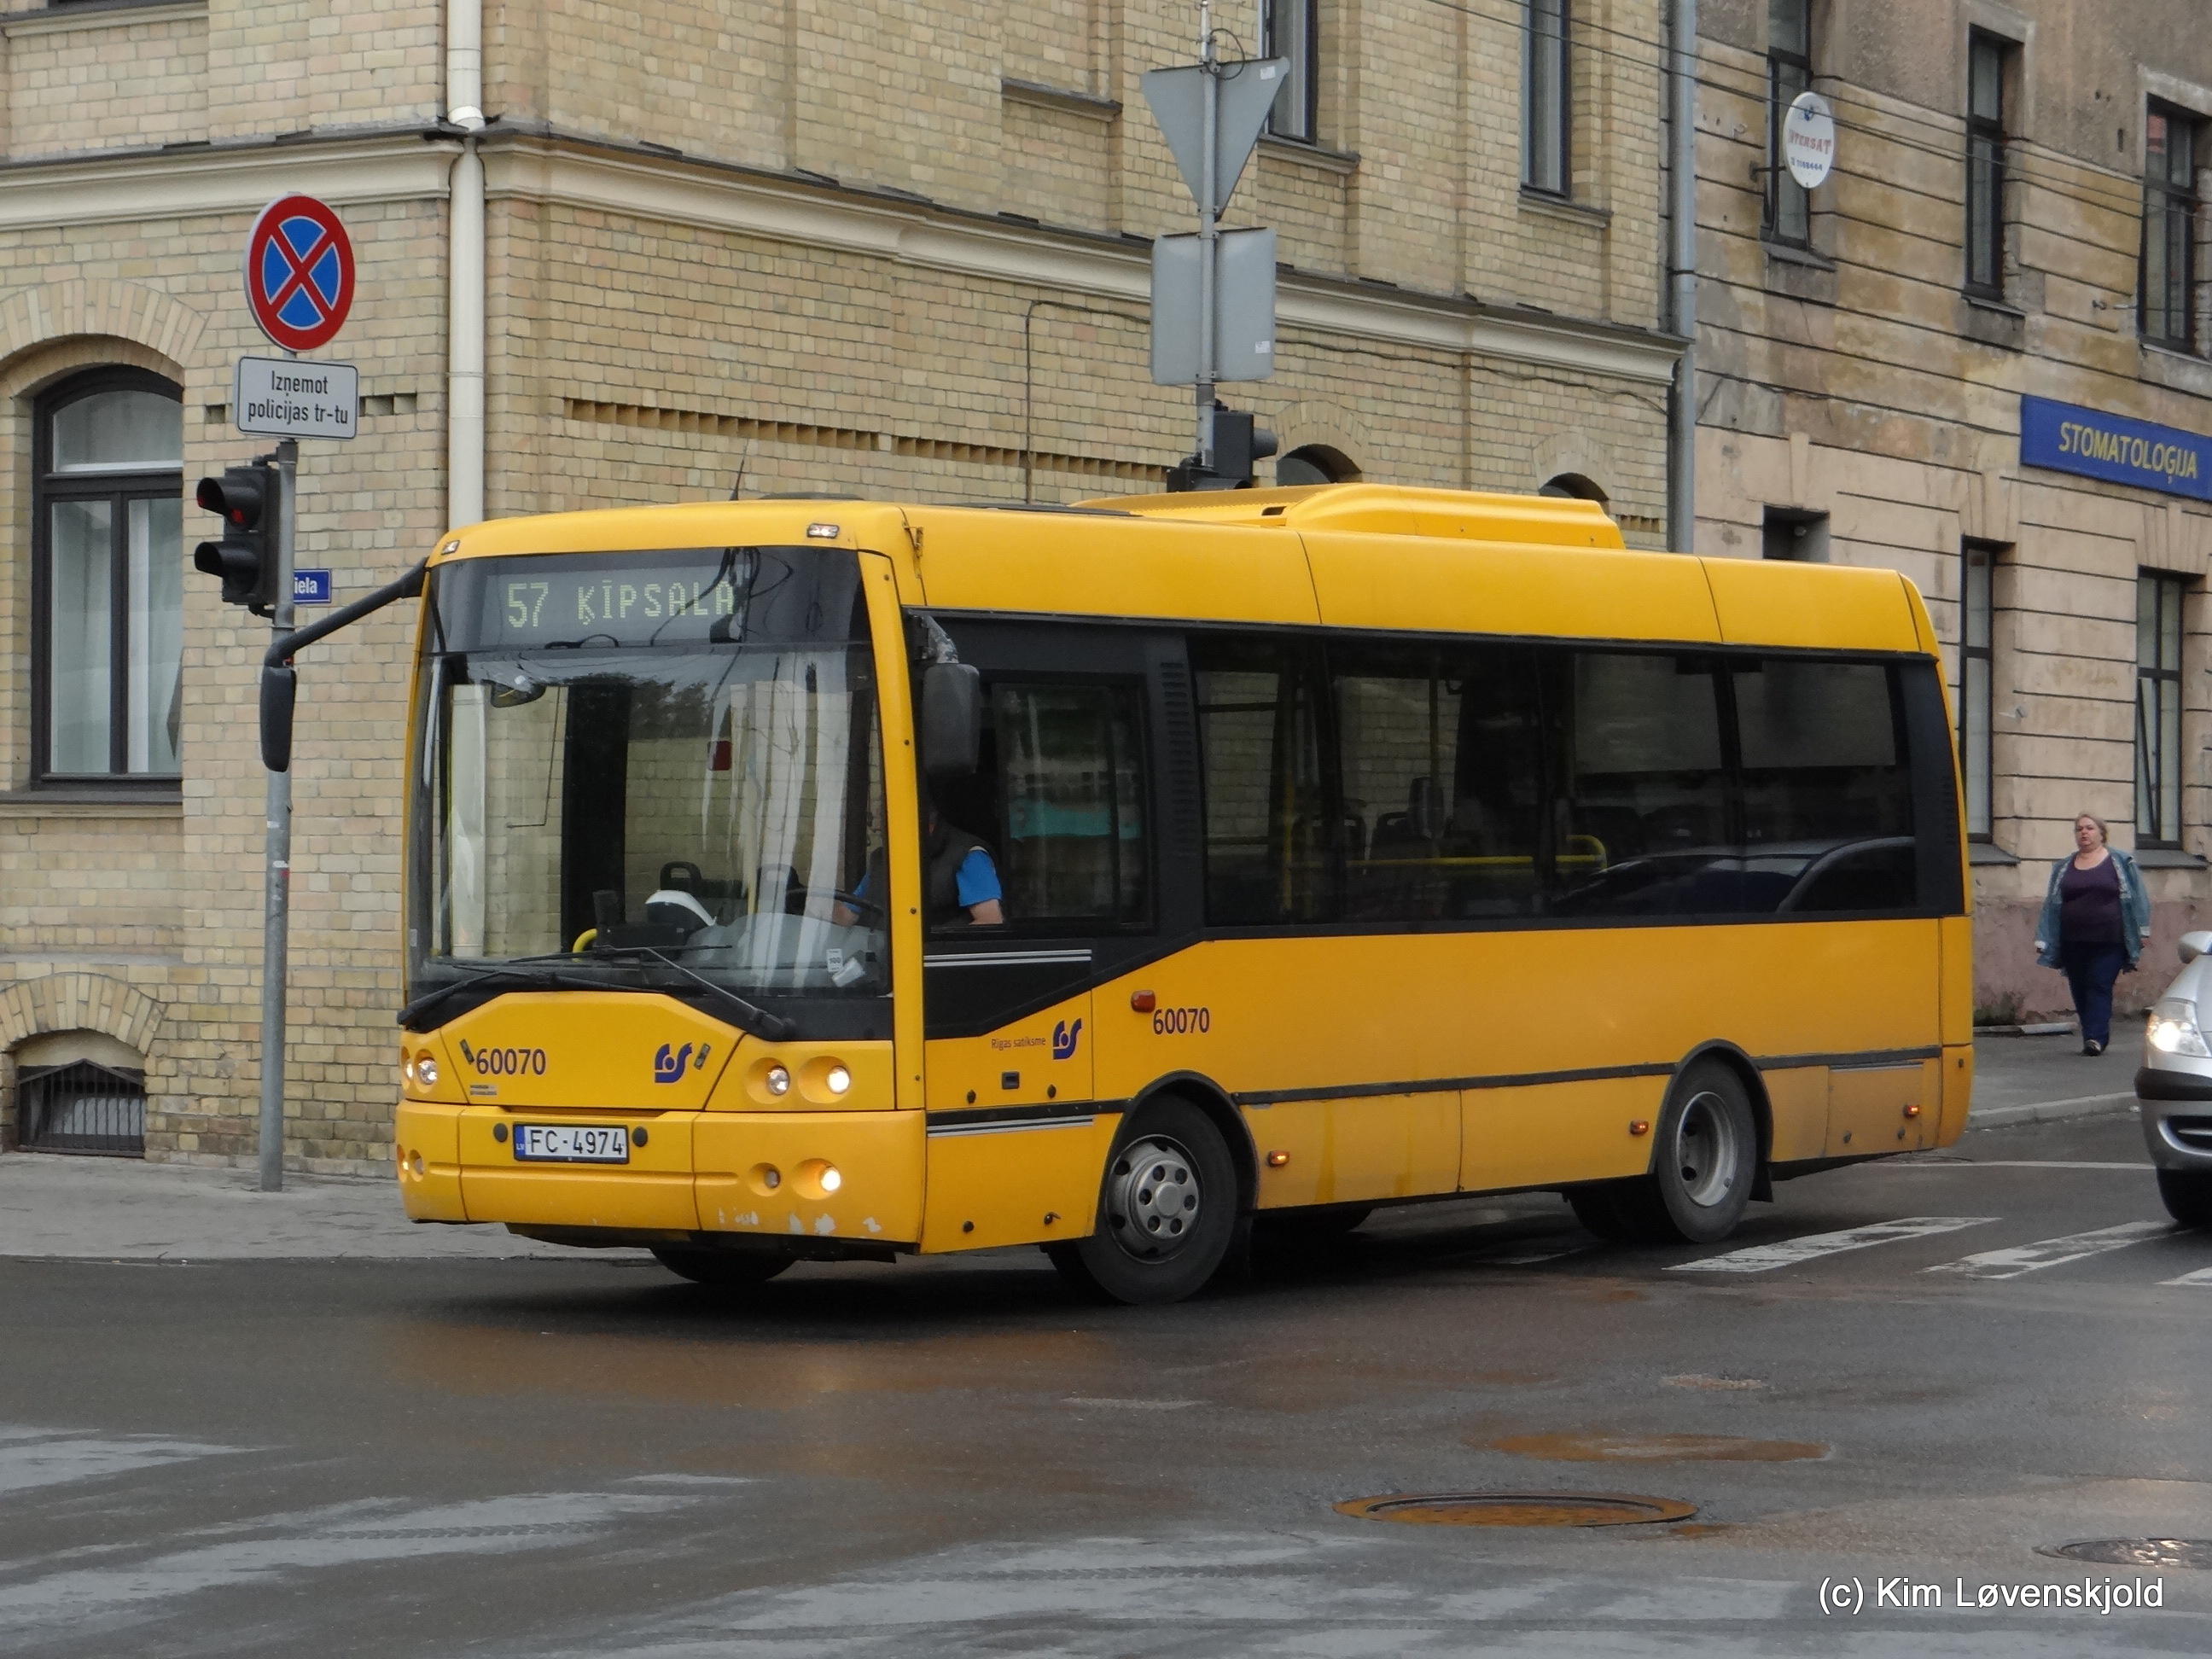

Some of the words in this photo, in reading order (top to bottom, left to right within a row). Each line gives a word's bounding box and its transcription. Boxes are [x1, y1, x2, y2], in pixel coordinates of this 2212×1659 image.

[271, 370, 329, 397] Izņemot
[247, 399, 309, 425] policijas
[313, 403, 349, 424] tr-tu
[2058, 421, 2199, 485] STOMATOLOĢIJA
[508, 581, 550, 627] 57
[577, 579, 735, 626] ĶĪPSALA
[1153, 1007, 1211, 1035] 60070
[475, 1047, 547, 1076] 60070
[515, 1142, 526, 1151] LV
[530, 1129, 623, 1155] FC-4974
